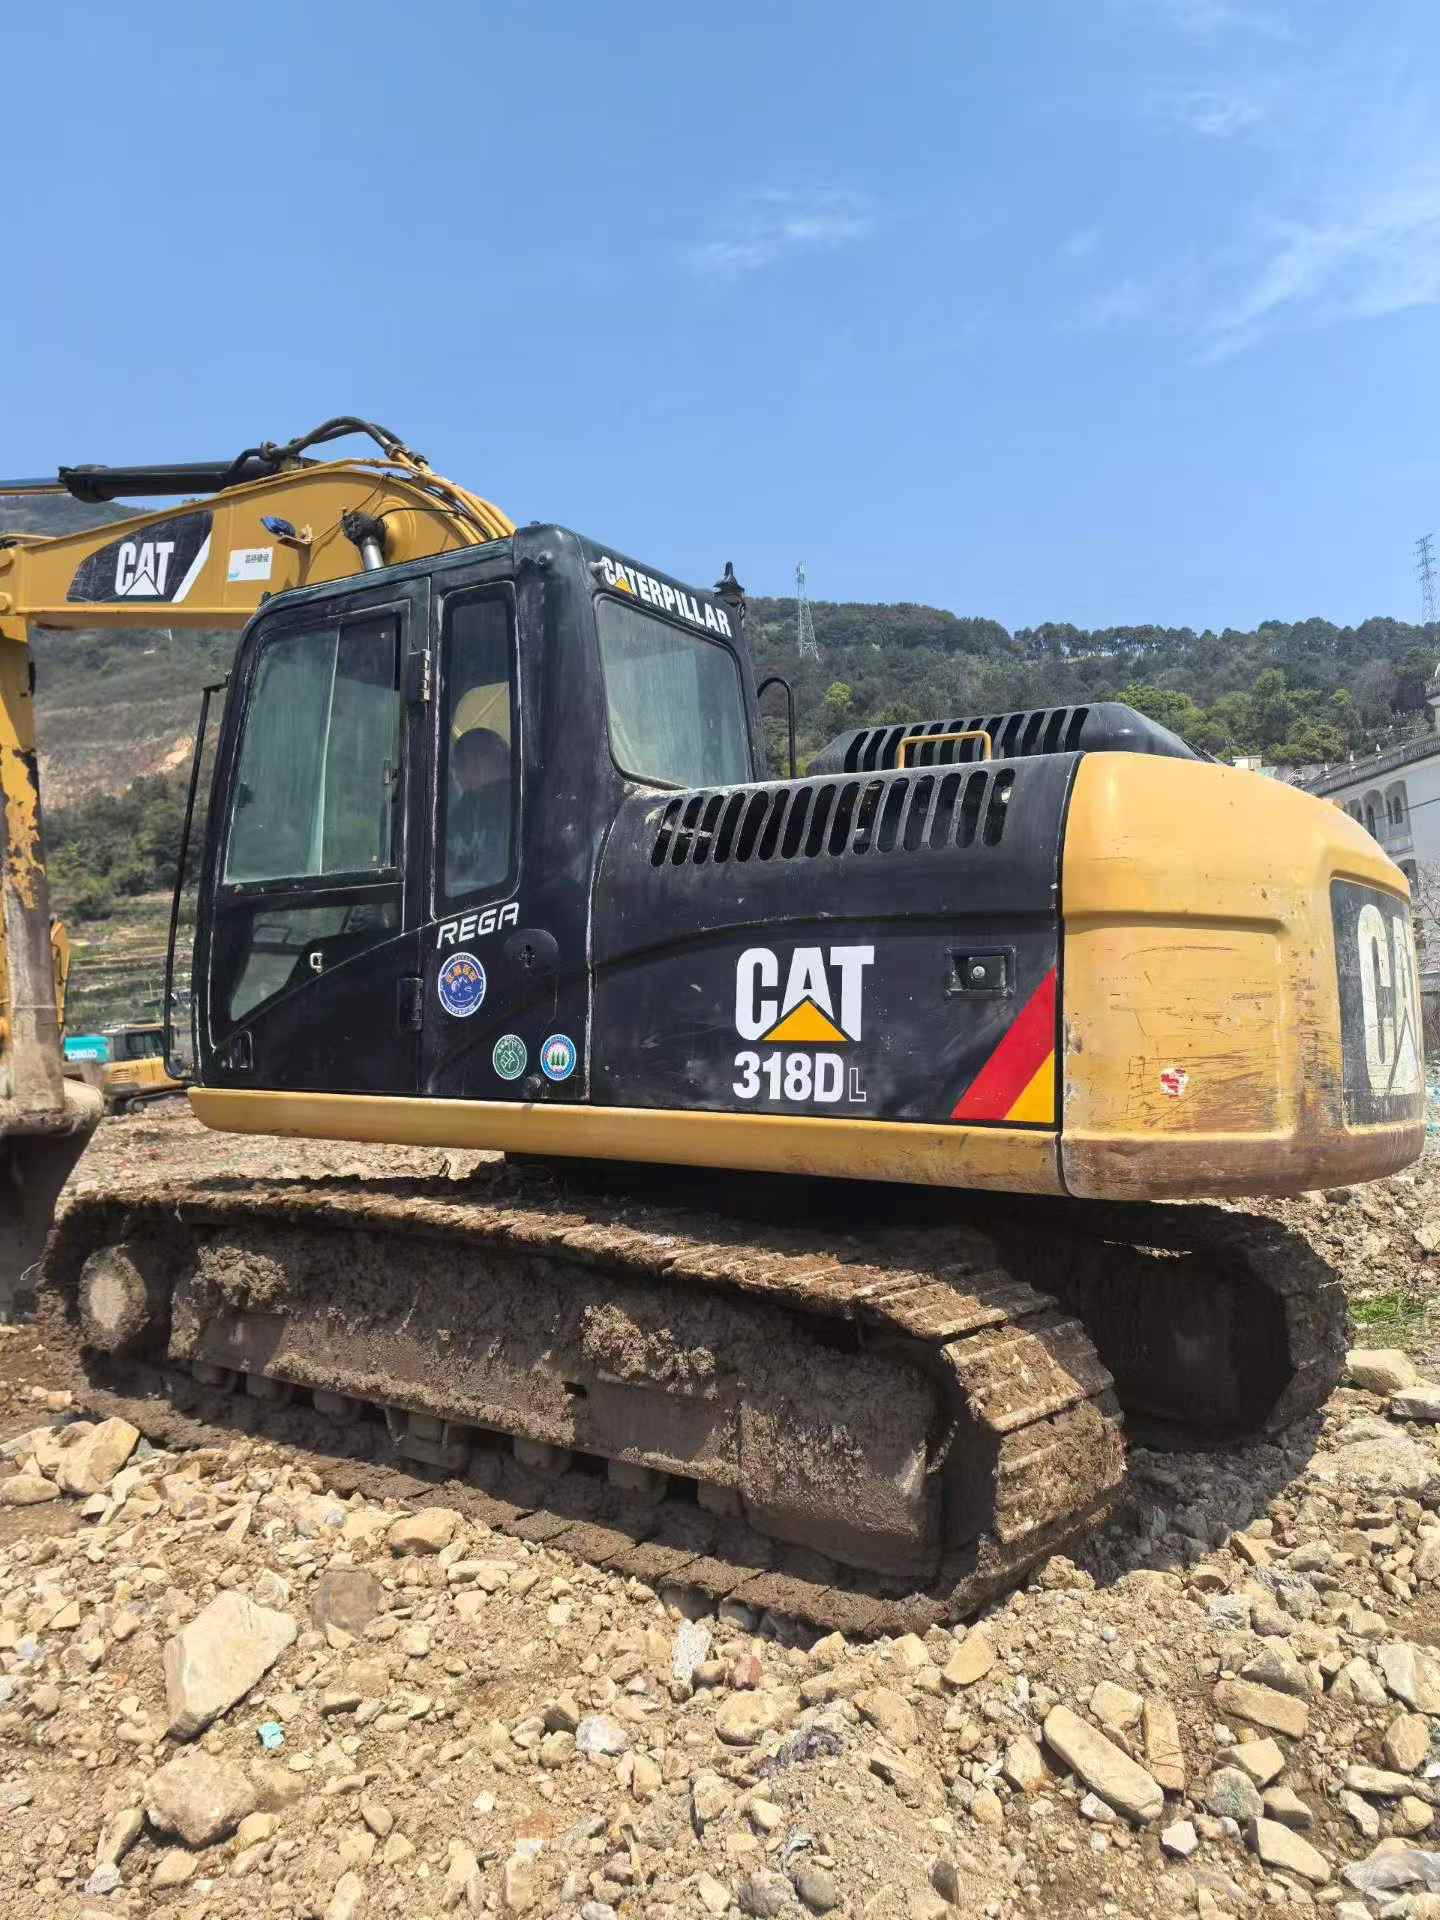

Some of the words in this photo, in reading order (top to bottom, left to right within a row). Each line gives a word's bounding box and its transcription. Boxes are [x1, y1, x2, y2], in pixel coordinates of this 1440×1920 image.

[115, 541, 175, 596] CAT
[601, 556, 732, 638] CATERPILLAR
[436, 902, 520, 950] REGA
[735, 945, 875, 1042] CAT
[1358, 904, 1423, 1097] CA
